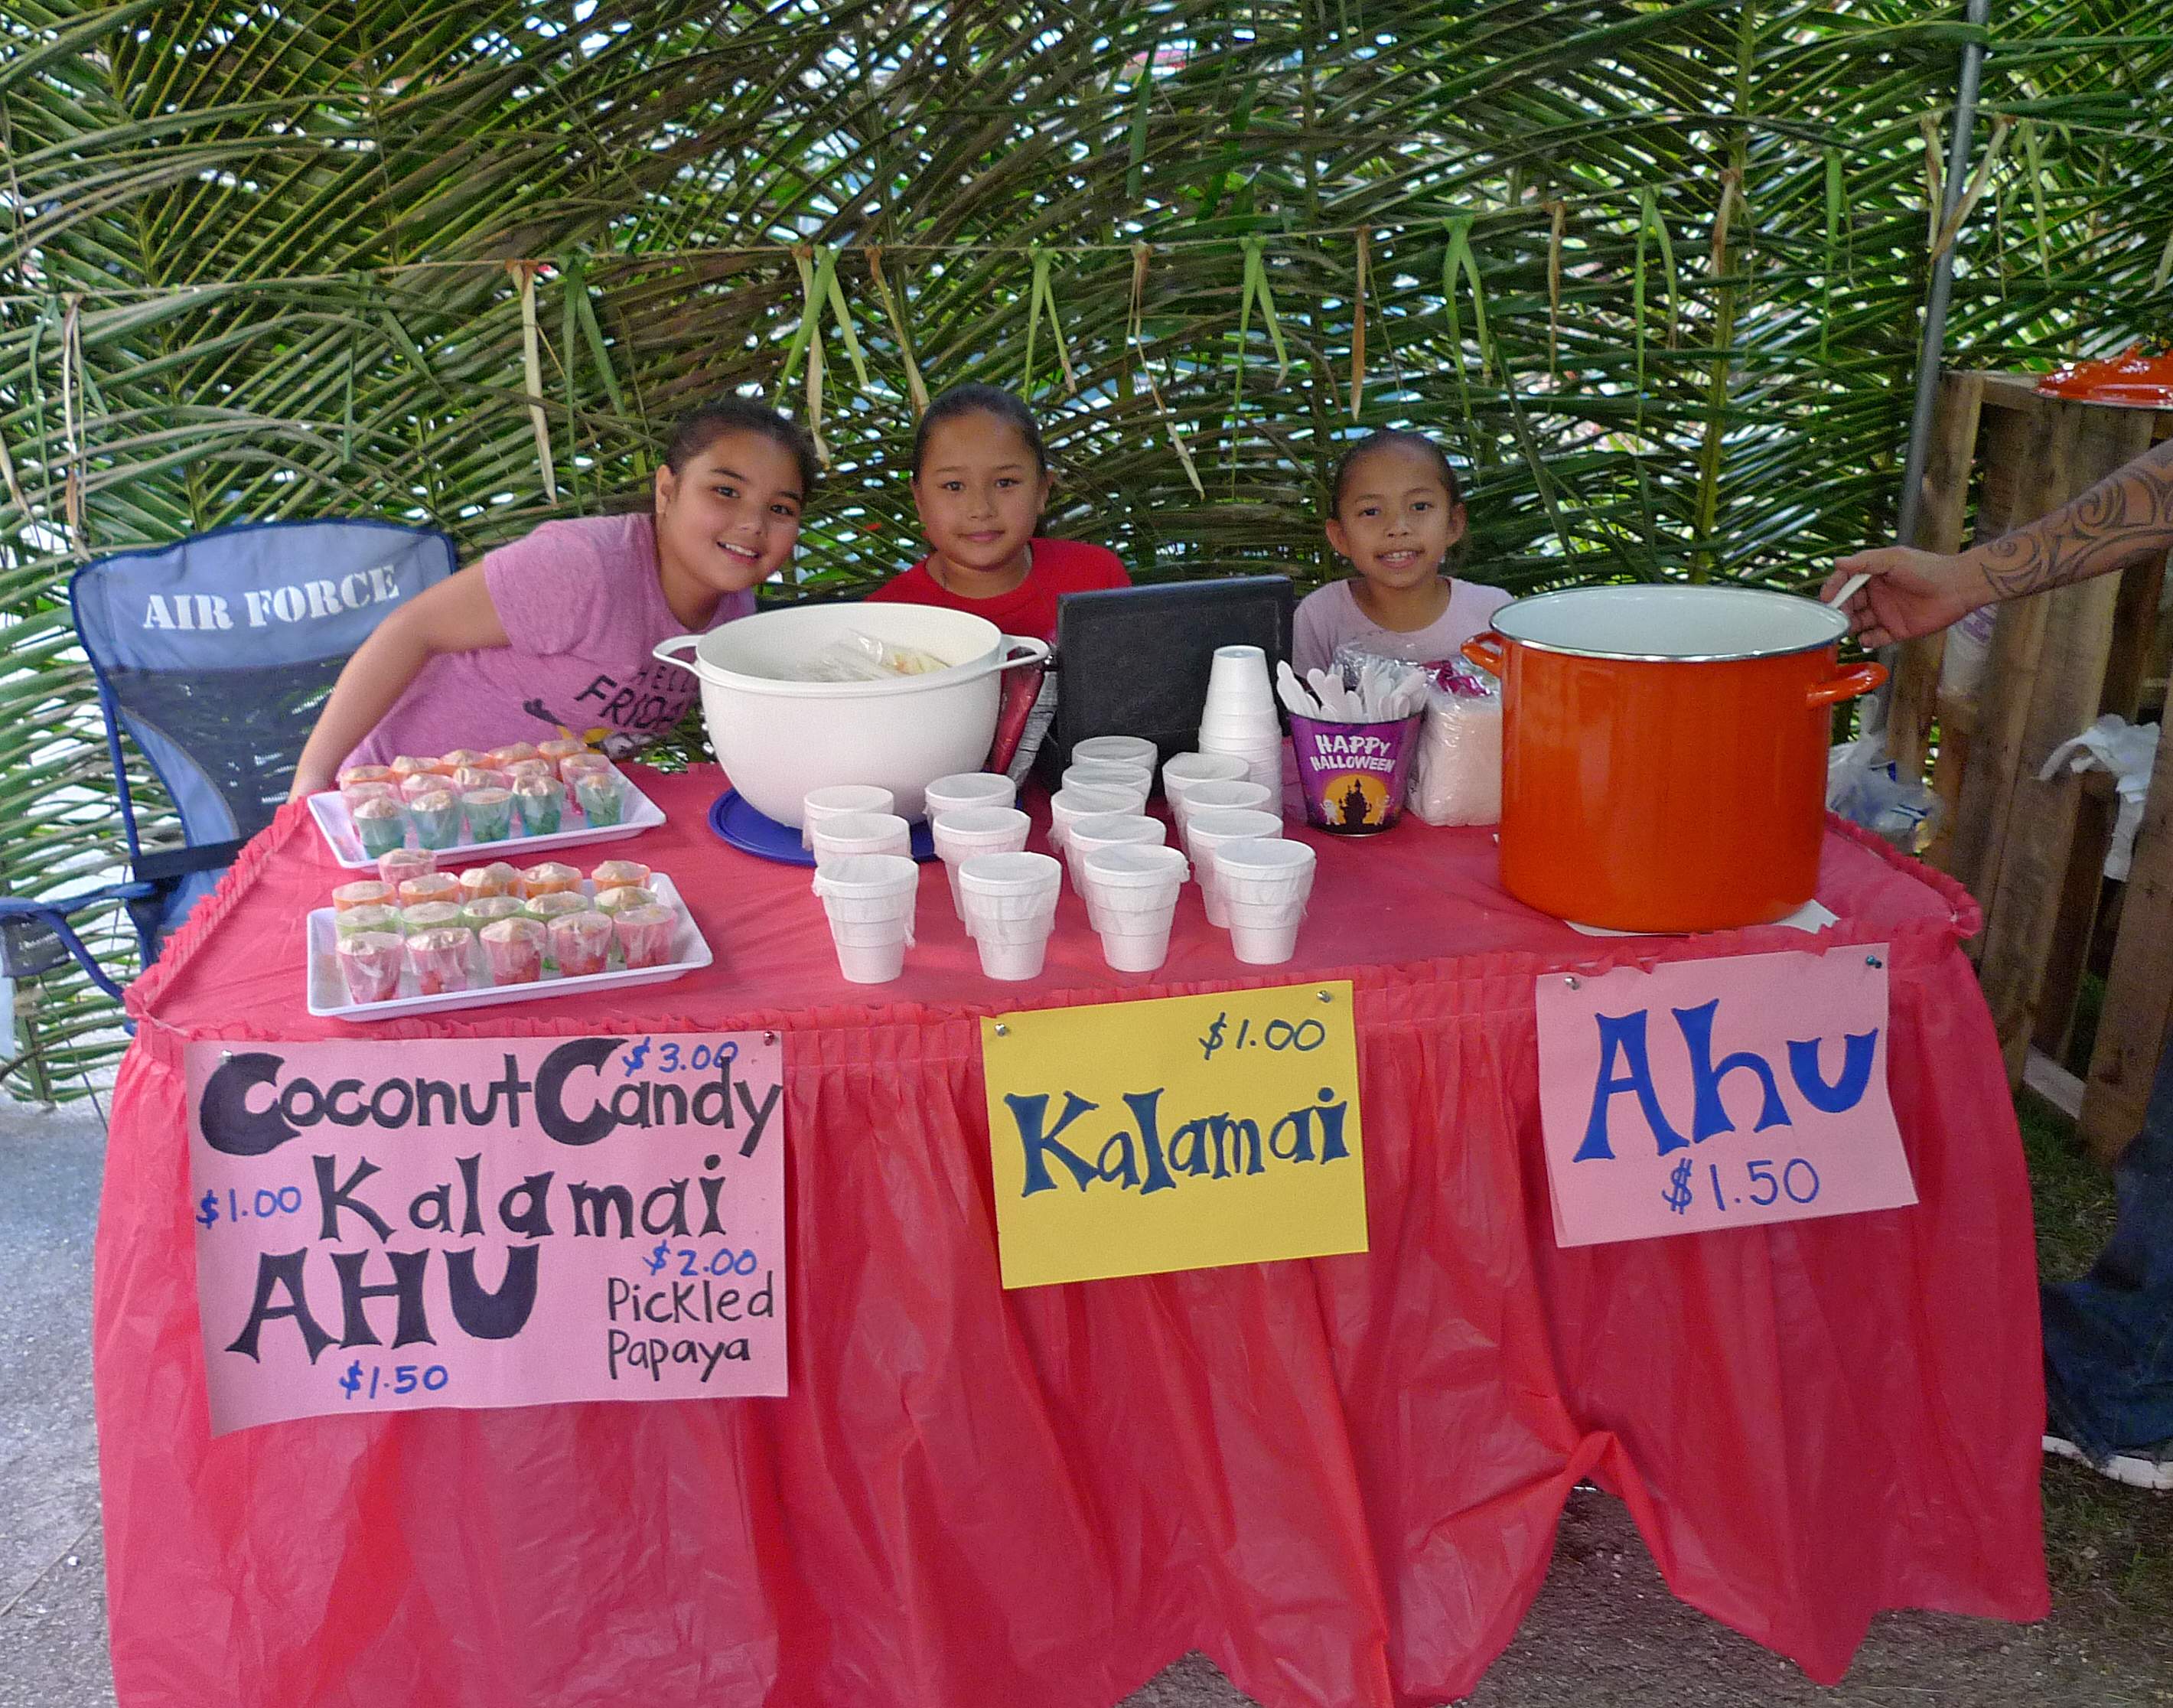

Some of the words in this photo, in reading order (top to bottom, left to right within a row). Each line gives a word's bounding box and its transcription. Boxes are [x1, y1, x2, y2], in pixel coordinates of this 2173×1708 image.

[142, 594, 233, 630] AIR
[243, 565, 400, 627] FORCE
[1309, 755, 1396, 773] HALLOWEEN
[1314, 734, 1391, 755] HAPPY
[621, 1036, 738, 1077] $3.00
[1198, 1012, 1326, 1061] $1.00
[199, 1052, 533, 1156] Coconut
[535, 1038, 784, 1158] Candy
[1572, 998, 1878, 1163] Ahu
[1003, 1087, 1350, 1198] Kalamai
[196, 1185, 301, 1229] $1.00
[312, 1152, 727, 1243] Kalamai
[1661, 1158, 1820, 1214] $1.50
[643, 1239, 757, 1276] $2.00
[225, 1244, 541, 1365] AHU
[607, 1270, 774, 1323] Pickled
[340, 1359, 449, 1400] $1.50
[607, 1328, 751, 1382] Papaya
